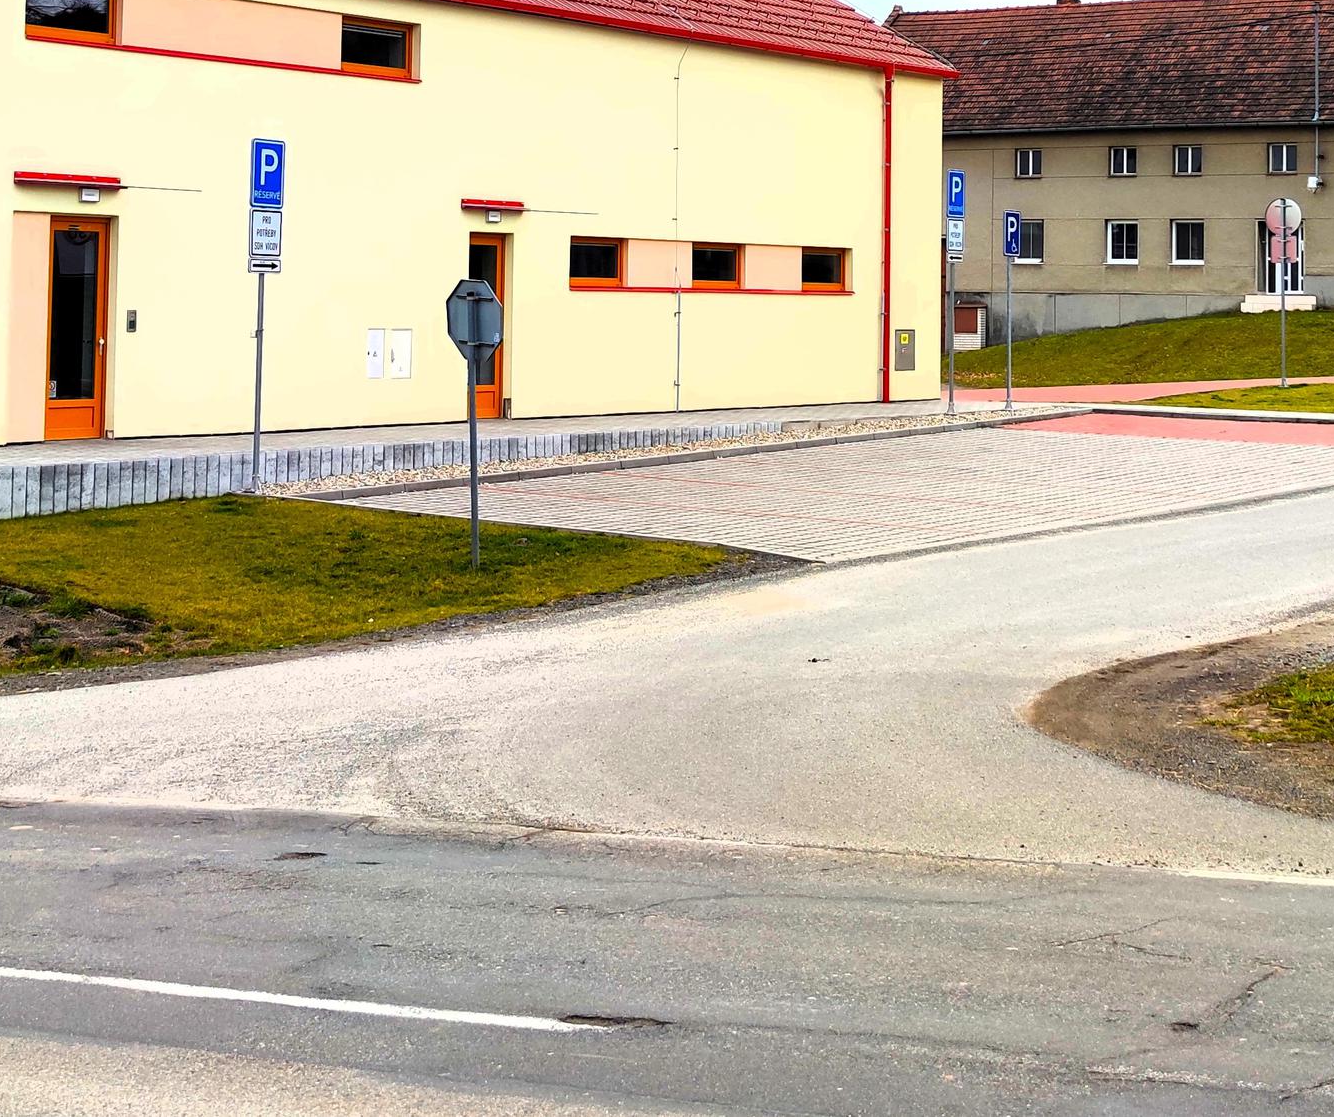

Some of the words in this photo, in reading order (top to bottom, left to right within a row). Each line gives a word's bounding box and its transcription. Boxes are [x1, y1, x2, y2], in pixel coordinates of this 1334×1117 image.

[260, 148, 279, 185] P
[952, 176, 962, 203] P
[262, 216, 271, 224] PRO
[1007, 216, 1017, 242] P
